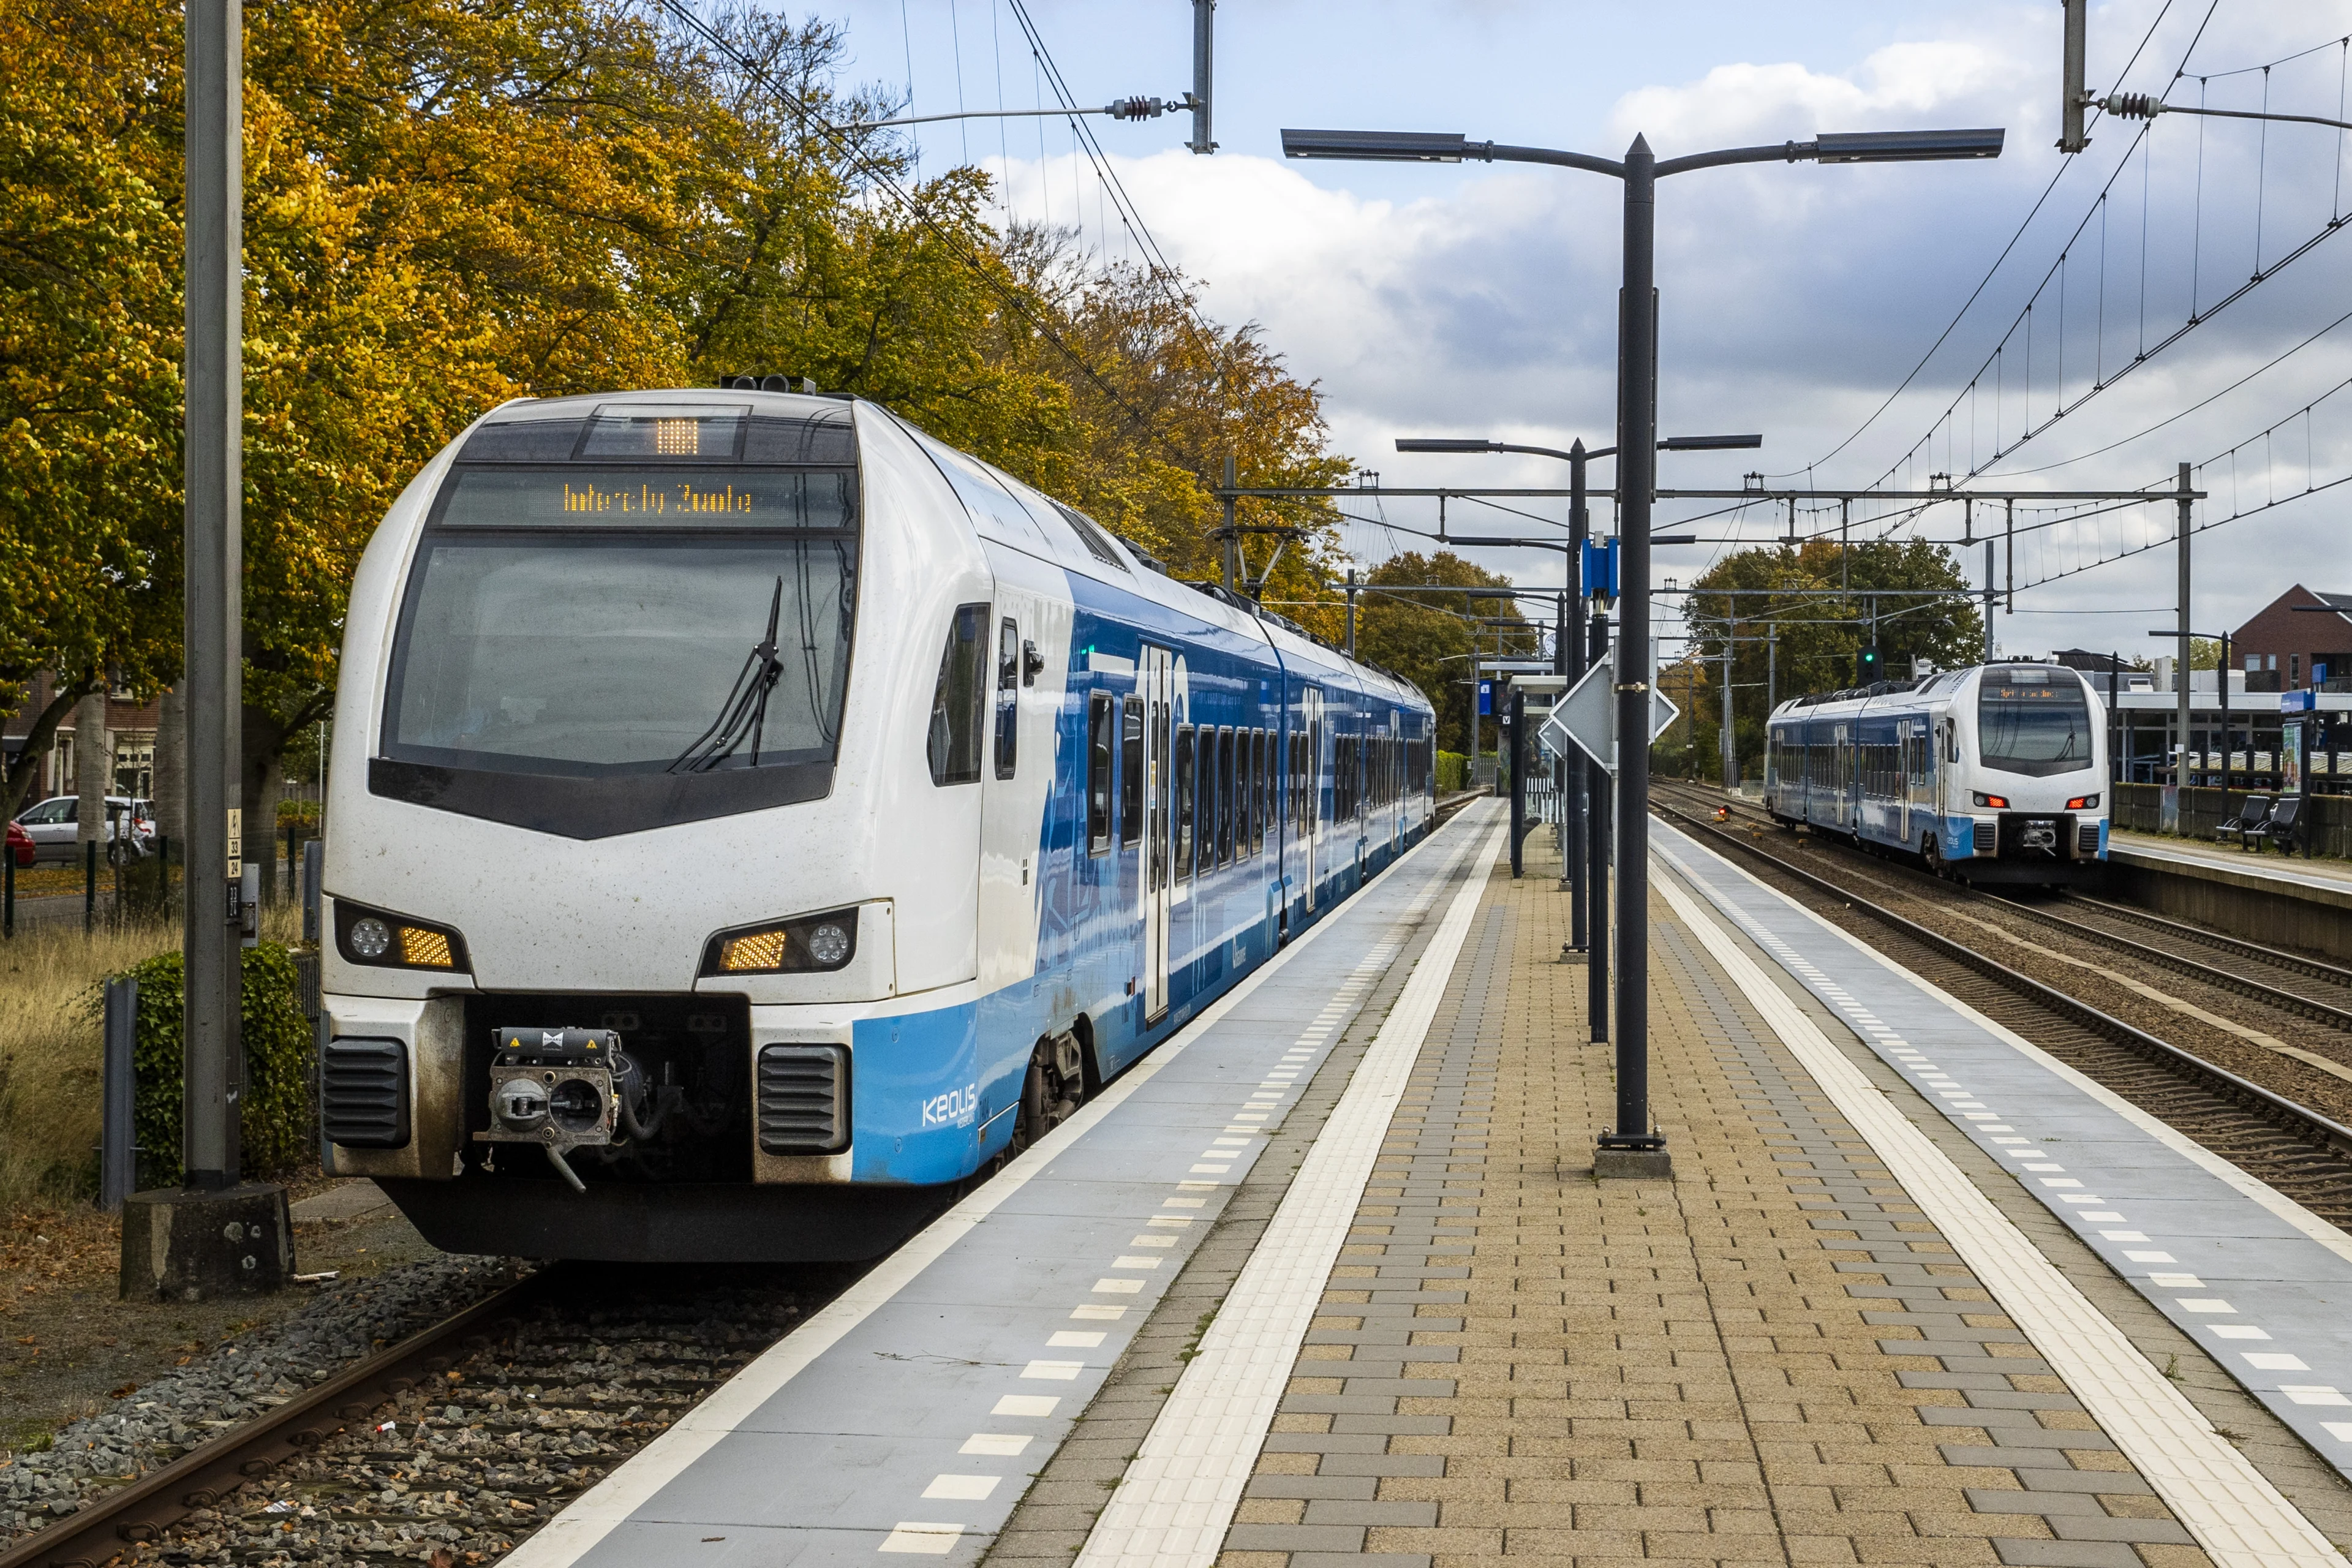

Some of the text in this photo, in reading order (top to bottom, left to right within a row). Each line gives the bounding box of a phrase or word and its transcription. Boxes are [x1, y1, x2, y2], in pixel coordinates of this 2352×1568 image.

[564, 483, 664, 514] Intercty
[231, 841, 238, 854] 33
[231, 862, 238, 875] 24
[230, 886, 237, 900] 33
[922, 1082, 976, 1128] KEOLIS
